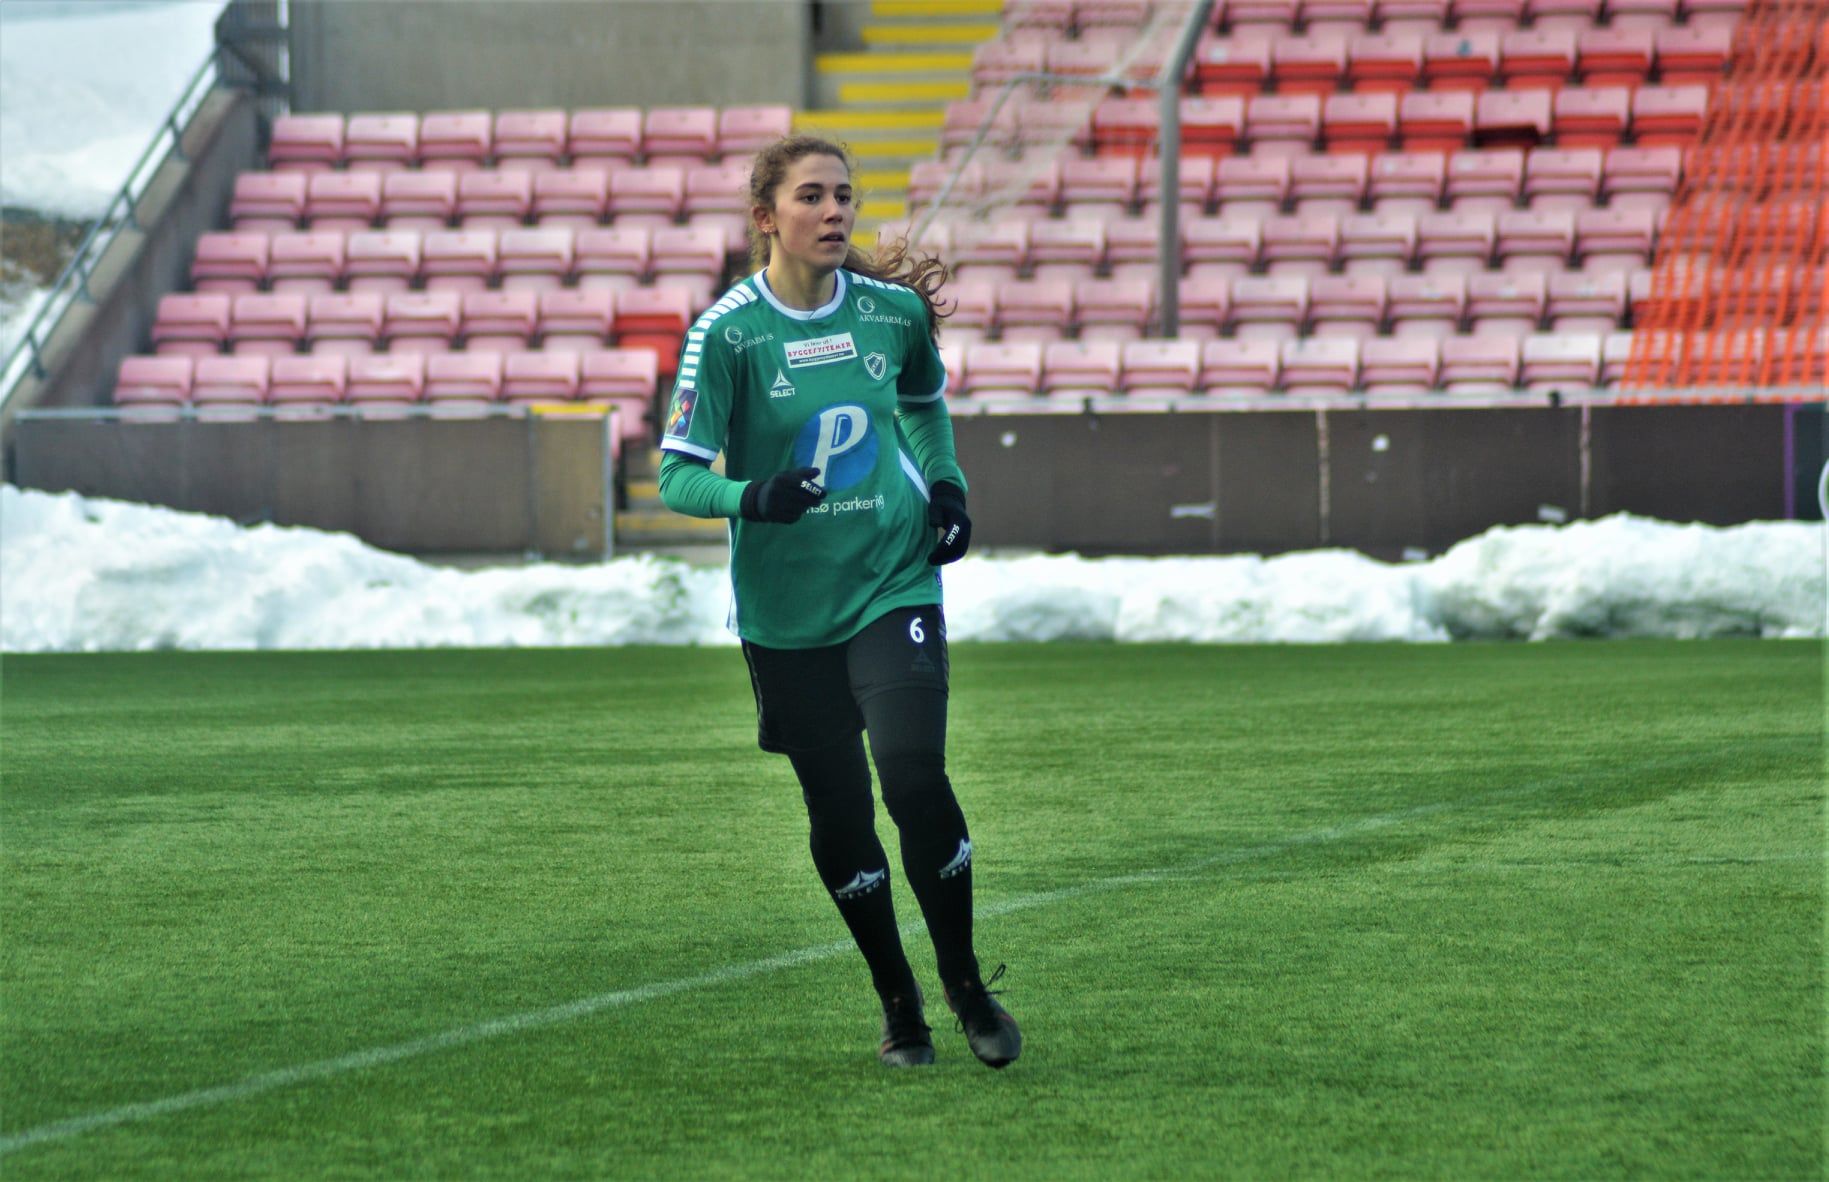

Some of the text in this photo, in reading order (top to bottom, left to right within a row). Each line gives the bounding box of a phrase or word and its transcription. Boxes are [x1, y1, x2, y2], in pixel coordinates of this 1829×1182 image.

[769, 387, 796, 399] SELECT
[811, 405, 869, 488] P
[800, 480, 823, 497] SELECT
[945, 523, 960, 546] SELECT
[909, 616, 925, 644] 6
